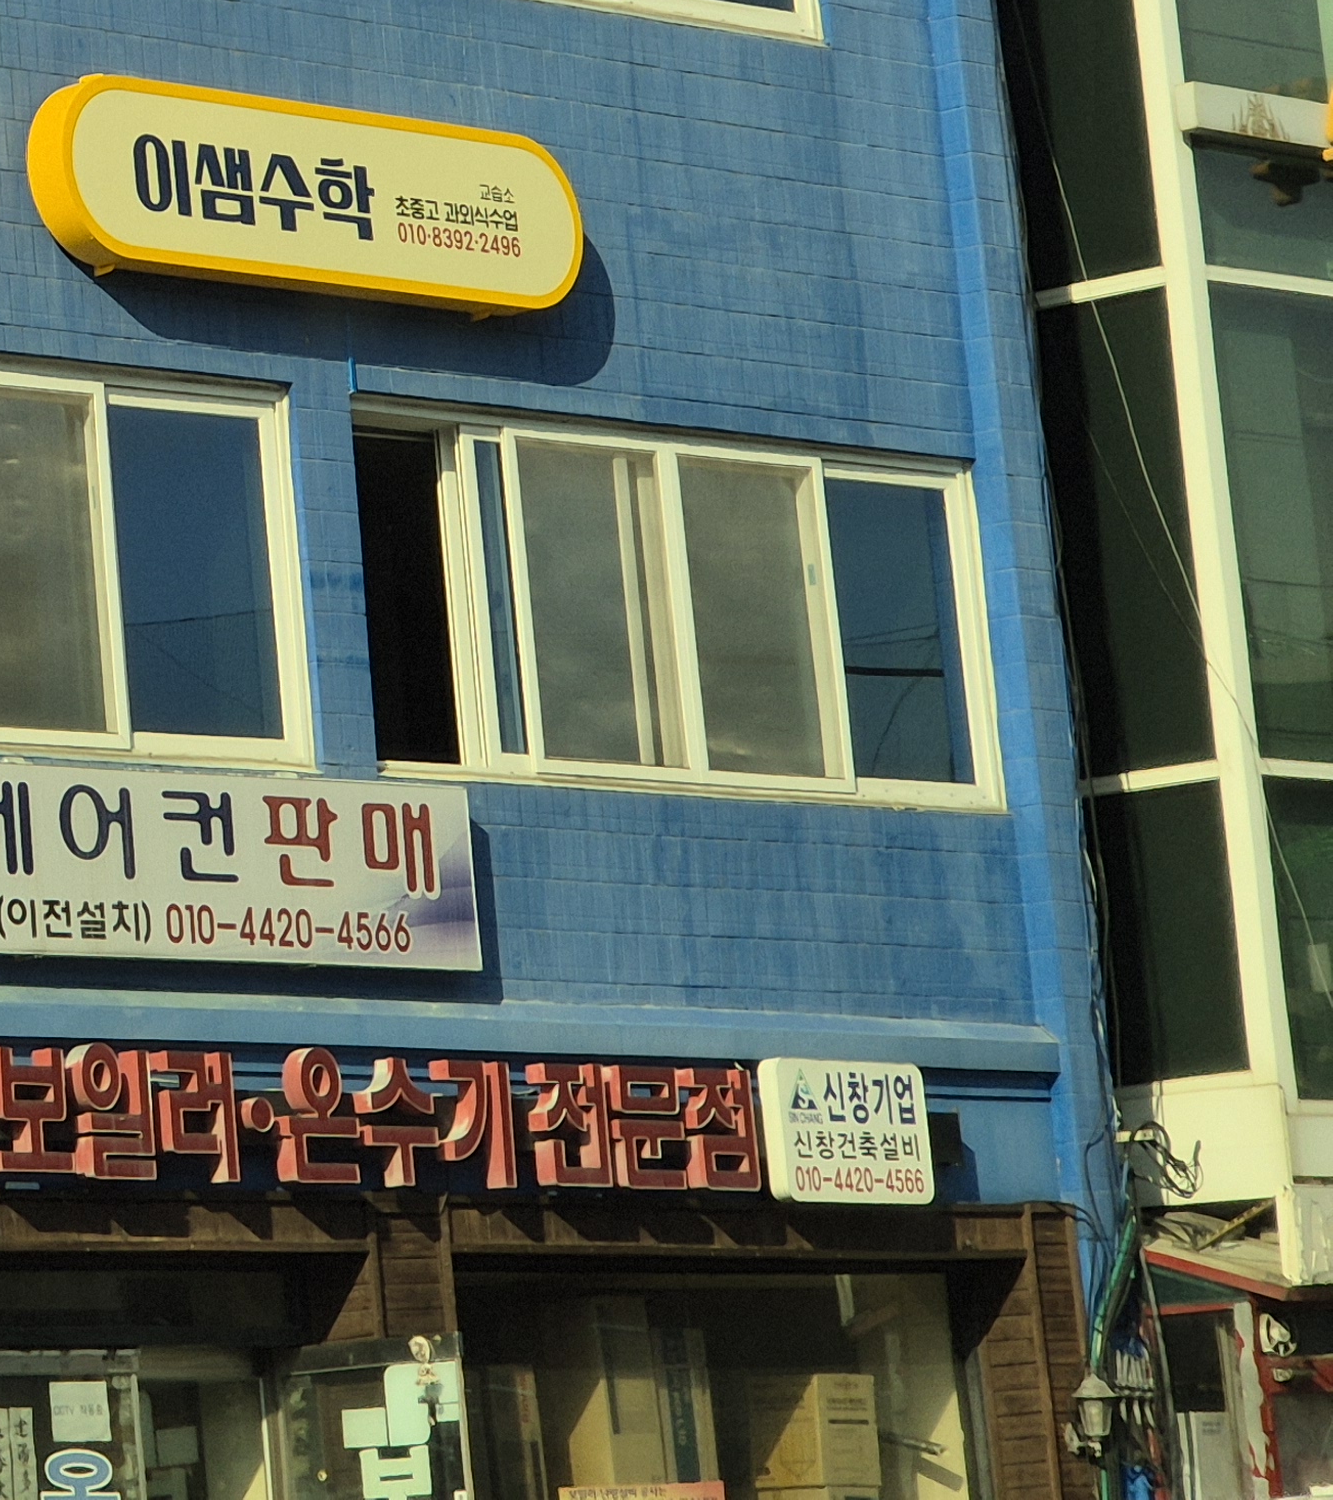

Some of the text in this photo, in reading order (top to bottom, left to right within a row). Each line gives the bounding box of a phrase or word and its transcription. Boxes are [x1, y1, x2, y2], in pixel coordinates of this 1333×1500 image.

[133, 133, 375, 241] 이샘수학
[479, 183, 515, 204] 교습소
[395, 195, 518, 232] 초중고 과외식수업
[166, 904, 412, 954] 010-4420-4566
[823, 1072, 916, 1125] 신창기업
[794, 1130, 920, 1161] 신창건축설비
[795, 1166, 924, 1193] 010-4420-4566
